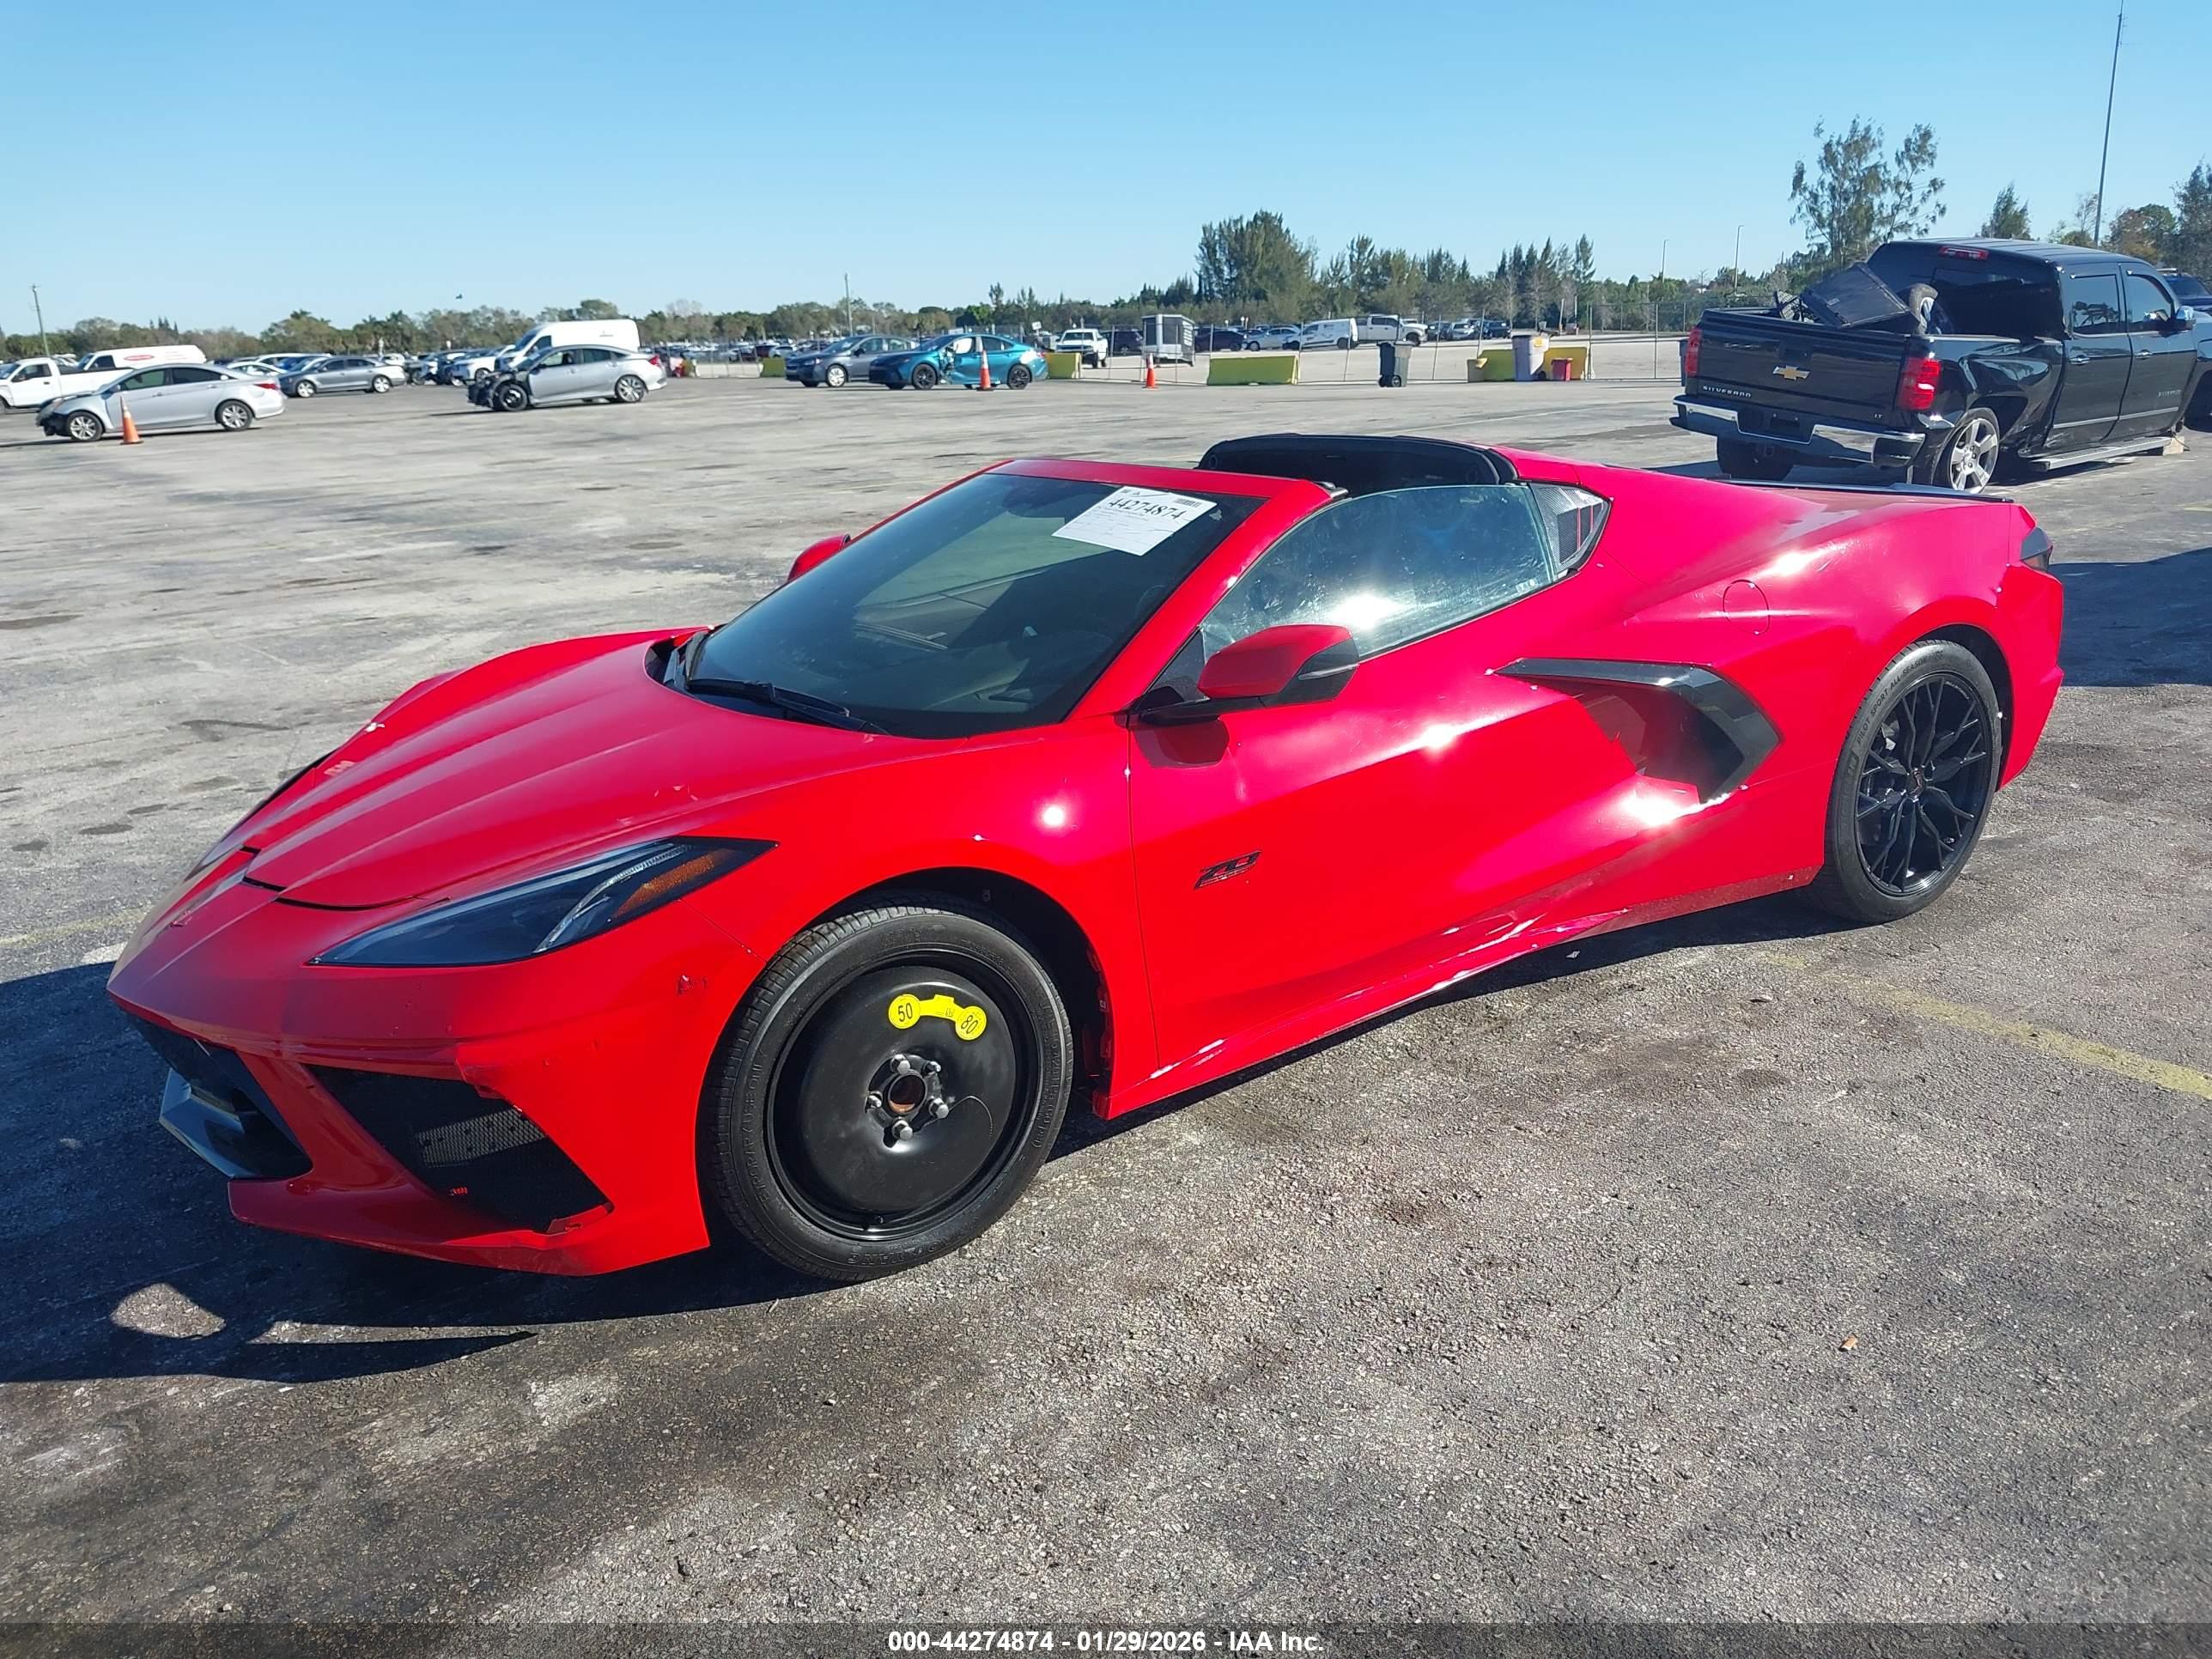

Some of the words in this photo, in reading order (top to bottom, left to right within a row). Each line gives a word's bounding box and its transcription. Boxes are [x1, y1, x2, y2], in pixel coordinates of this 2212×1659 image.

[1107, 497, 1188, 520] 44274874
[1855, 718, 1871, 744] PILOT
[1870, 690, 1888, 716] SPORT
[1890, 676, 1901, 690] ALL
[897, 1002, 914, 1023] 50
[960, 1014, 979, 1035] 80
